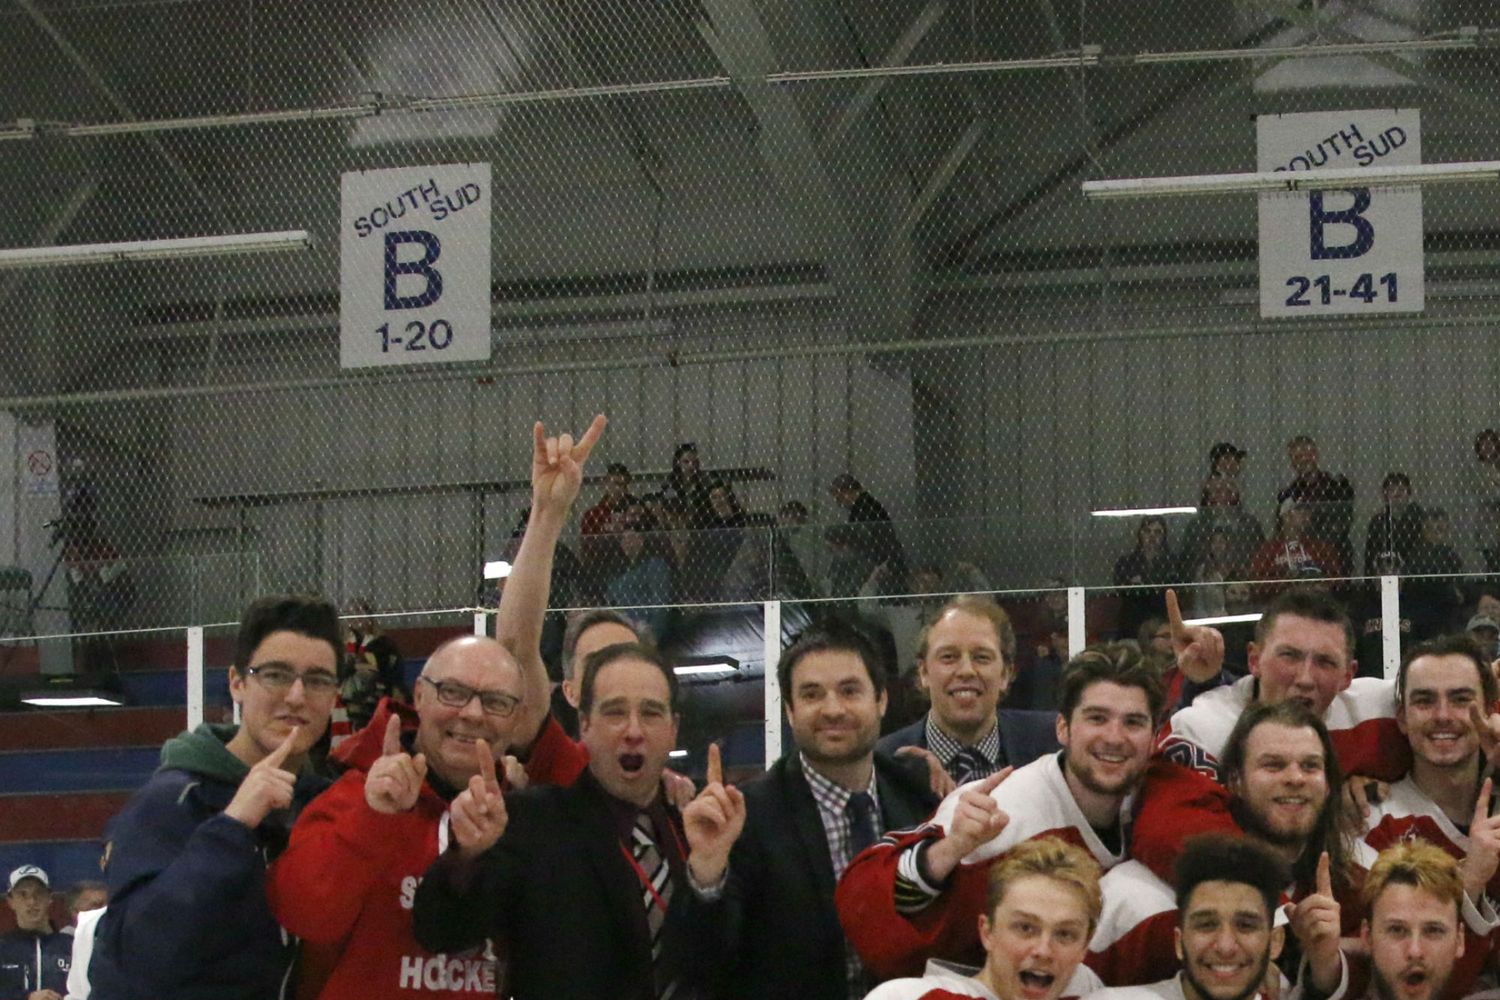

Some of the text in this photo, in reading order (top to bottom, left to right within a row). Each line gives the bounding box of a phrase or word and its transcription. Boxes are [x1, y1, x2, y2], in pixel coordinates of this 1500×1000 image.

[1273, 123, 1365, 172] OUTH
[1352, 125, 1408, 167] SUD
[353, 178, 440, 238] SOUTH
[429, 182, 481, 221] SUD
[1308, 187, 1375, 260] B
[383, 230, 444, 311] B
[1284, 272, 1399, 307] 21-41
[375, 319, 454, 353] 1-20
